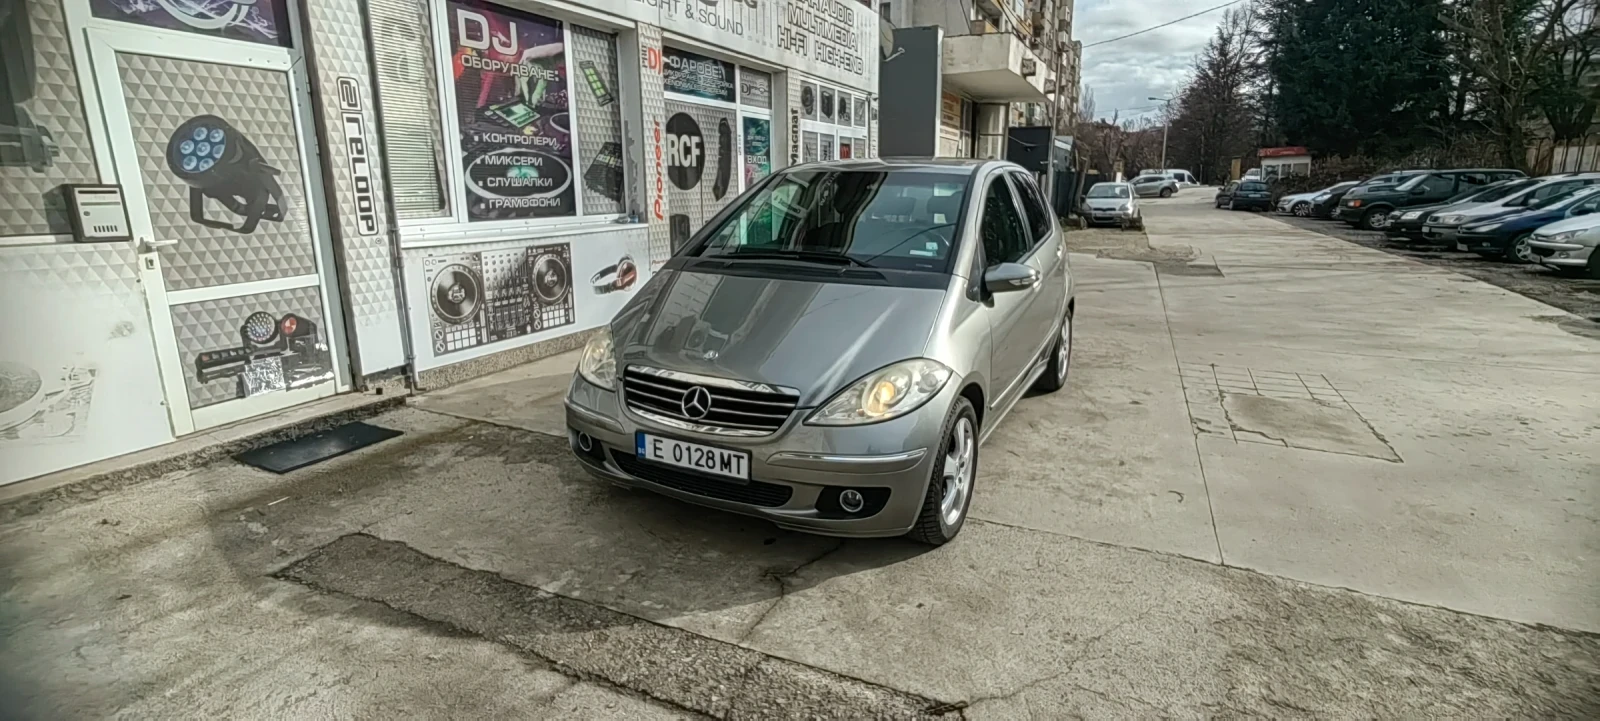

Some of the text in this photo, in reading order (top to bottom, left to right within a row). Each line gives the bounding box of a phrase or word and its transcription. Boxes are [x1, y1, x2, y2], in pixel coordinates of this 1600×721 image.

[457, 8, 518, 56] DJ
[685, 4, 694, 20] &
[698, 8, 744, 36] SOUND
[787, 2, 858, 52] MULTIMEDIA
[777, 25, 864, 76] HI-FI HIGH-END
[461, 54, 559, 82] ОБОРУДВАНЕ:
[482, 132, 557, 147] КОНТРОЛЕРИ
[667, 133, 701, 168] RCF
[485, 155, 543, 167] МИКСЕРИ
[653, 116, 664, 222] Pioneer
[487, 177, 553, 188] СЛУШАЛКИ
[489, 198, 561, 209] ГРАМОФОНИ
[653, 439, 745, 475] E 0128 MT
